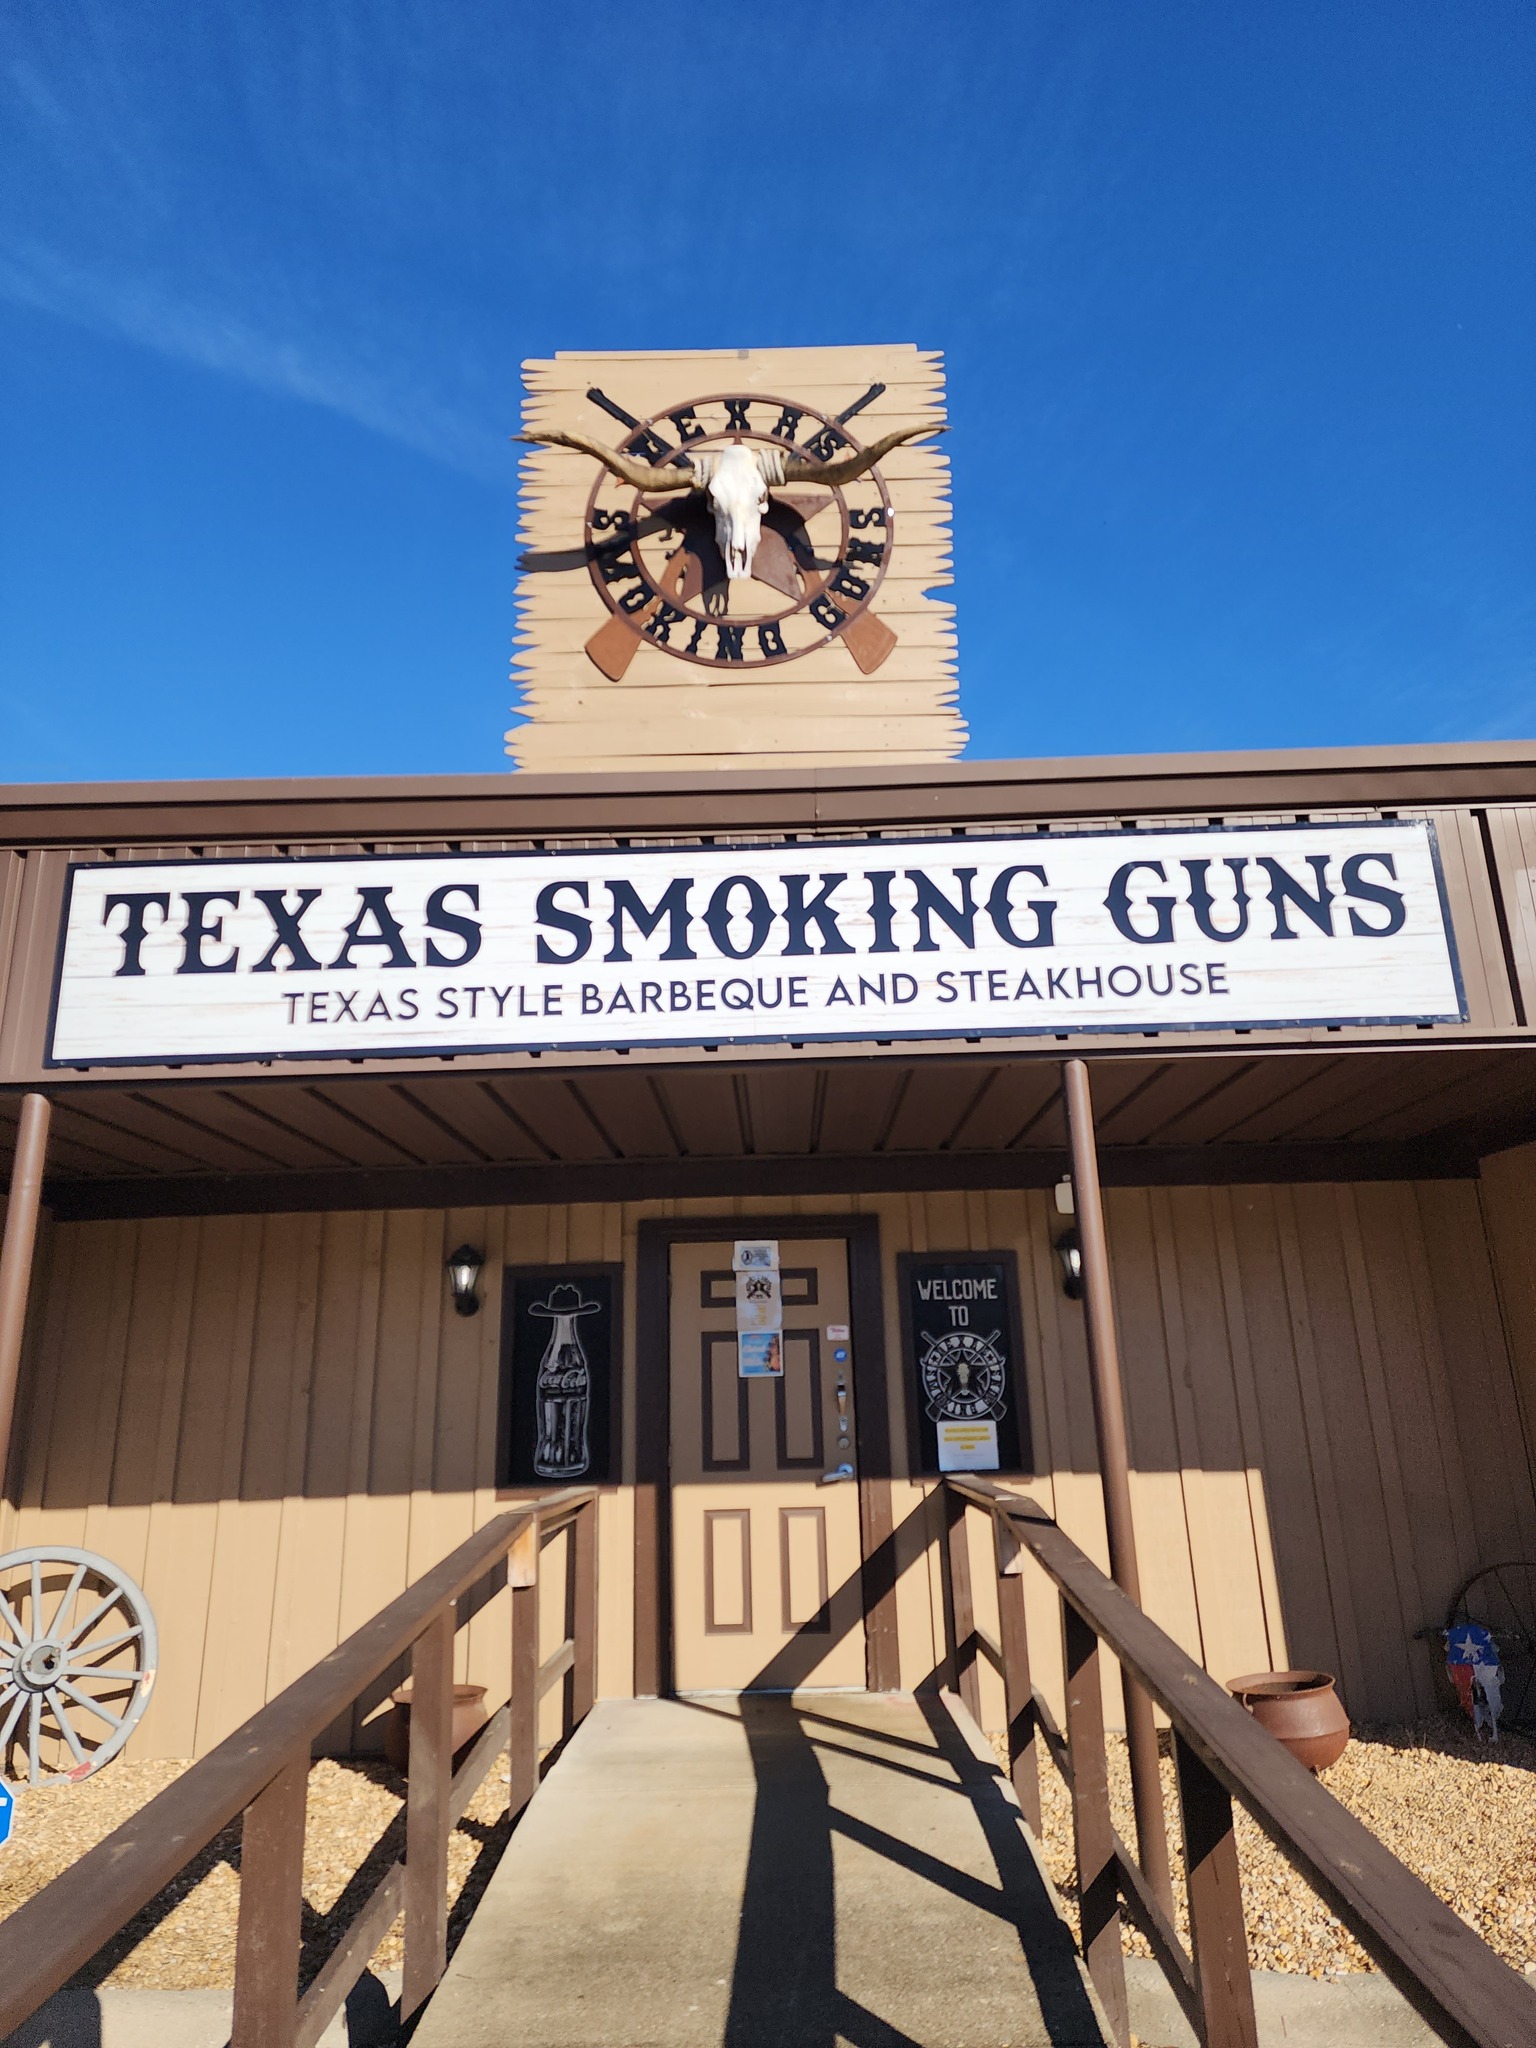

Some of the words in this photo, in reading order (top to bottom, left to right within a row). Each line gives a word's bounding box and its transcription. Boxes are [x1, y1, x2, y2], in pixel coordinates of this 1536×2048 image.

[624, 399, 847, 466] TEXAS
[592, 508, 788, 662] SMOKING
[809, 507, 887, 631] GUNS
[103, 884, 482, 976] TEXAS
[535, 865, 1057, 965] SMOKING
[1103, 853, 1406, 944] GUNS
[284, 989, 418, 1024] TEXAS
[438, 985, 563, 1019] STYLE
[582, 977, 808, 1015] BARBEQUE
[826, 973, 918, 1006] AND
[937, 963, 1229, 1003] STEAKHOUSE
[917, 1279, 998, 1300] WELCOME
[948, 1305, 969, 1326] TO
